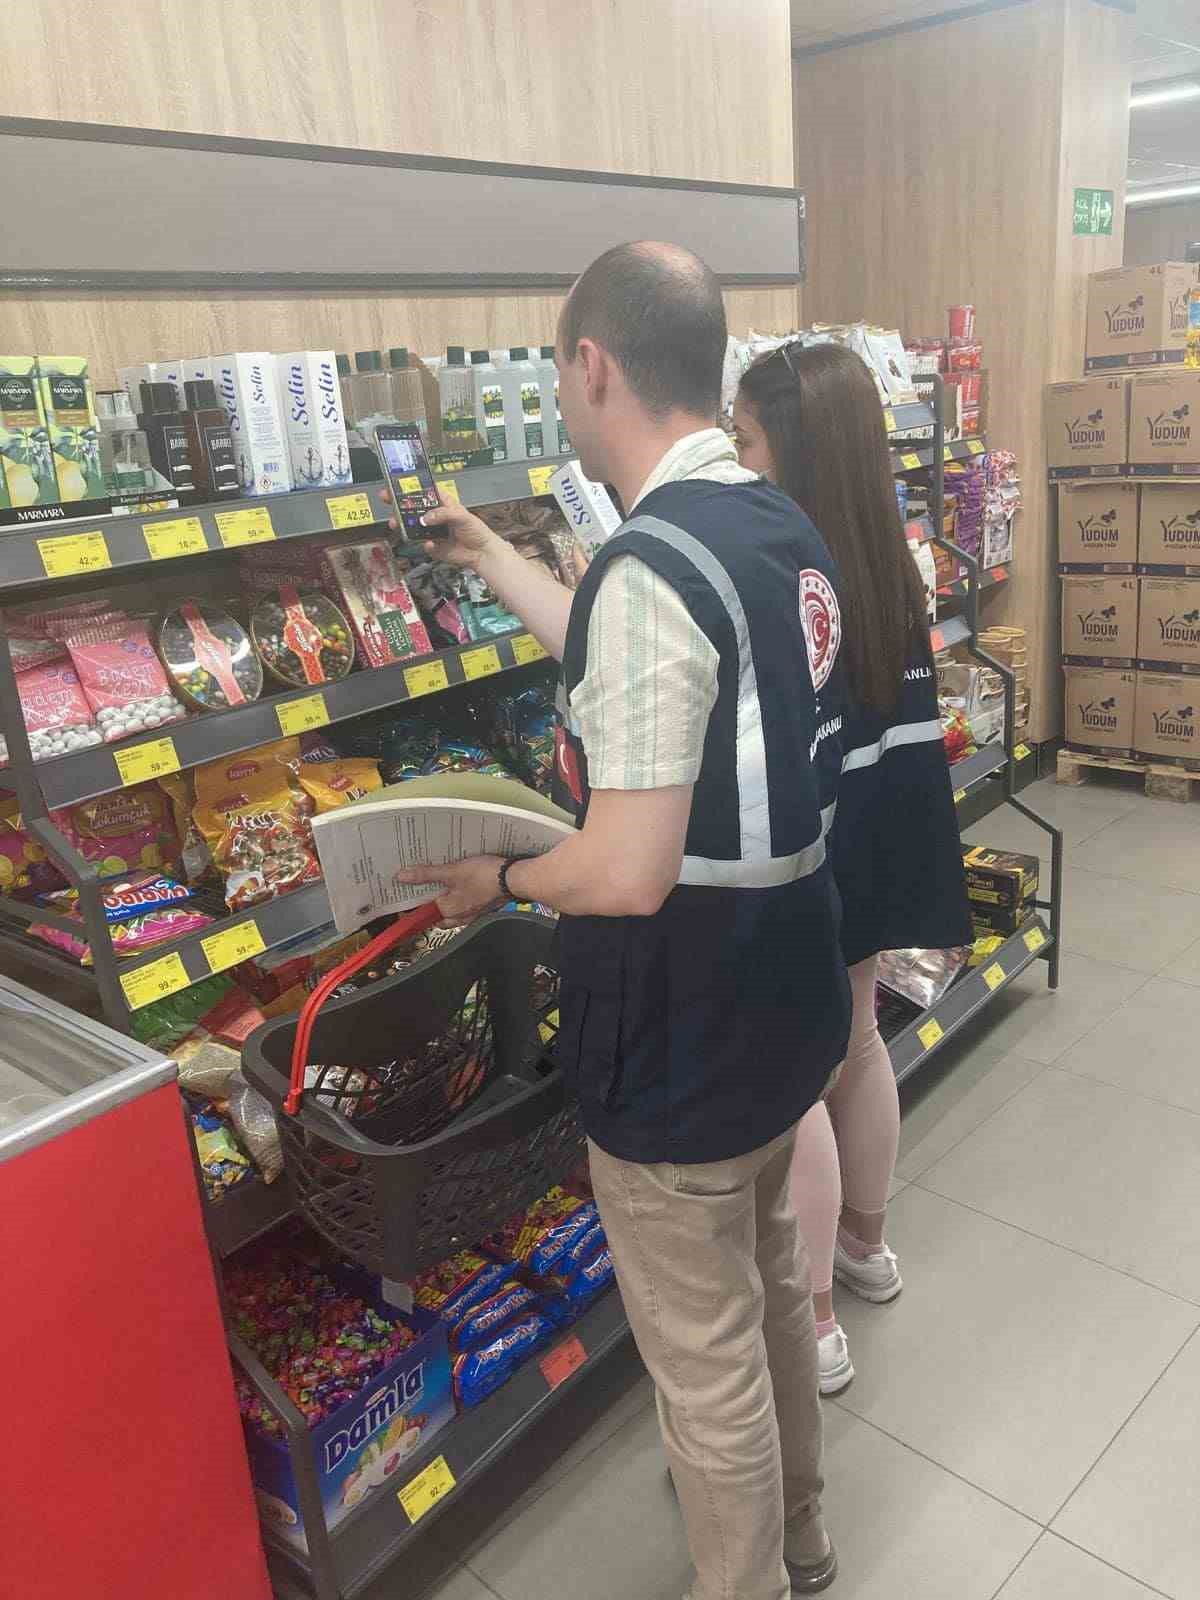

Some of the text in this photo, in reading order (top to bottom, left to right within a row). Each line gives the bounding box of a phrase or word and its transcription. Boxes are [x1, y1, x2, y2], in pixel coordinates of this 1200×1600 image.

[1104, 304, 1145, 333] YUDUM
[251, 366, 264, 404] Selin
[288, 366, 309, 426] Selin
[320, 363, 338, 423] Selin
[221, 369, 240, 431] Selin
[1064, 418, 1105, 444] YUDUM
[1147, 410, 1191, 441] YUDUM
[17, 507, 65, 521] MARMARA
[561, 478, 591, 525] Selin
[1077, 514, 1119, 542] YUDUM
[1160, 514, 1200, 542] YUDUM
[1077, 611, 1119, 636] YUDUM
[1158, 615, 1200, 641] YUDUM
[1079, 702, 1117, 728] YUDUM
[1153, 710, 1194, 737] YUDUM
[325, 1361, 425, 1475] Damla
